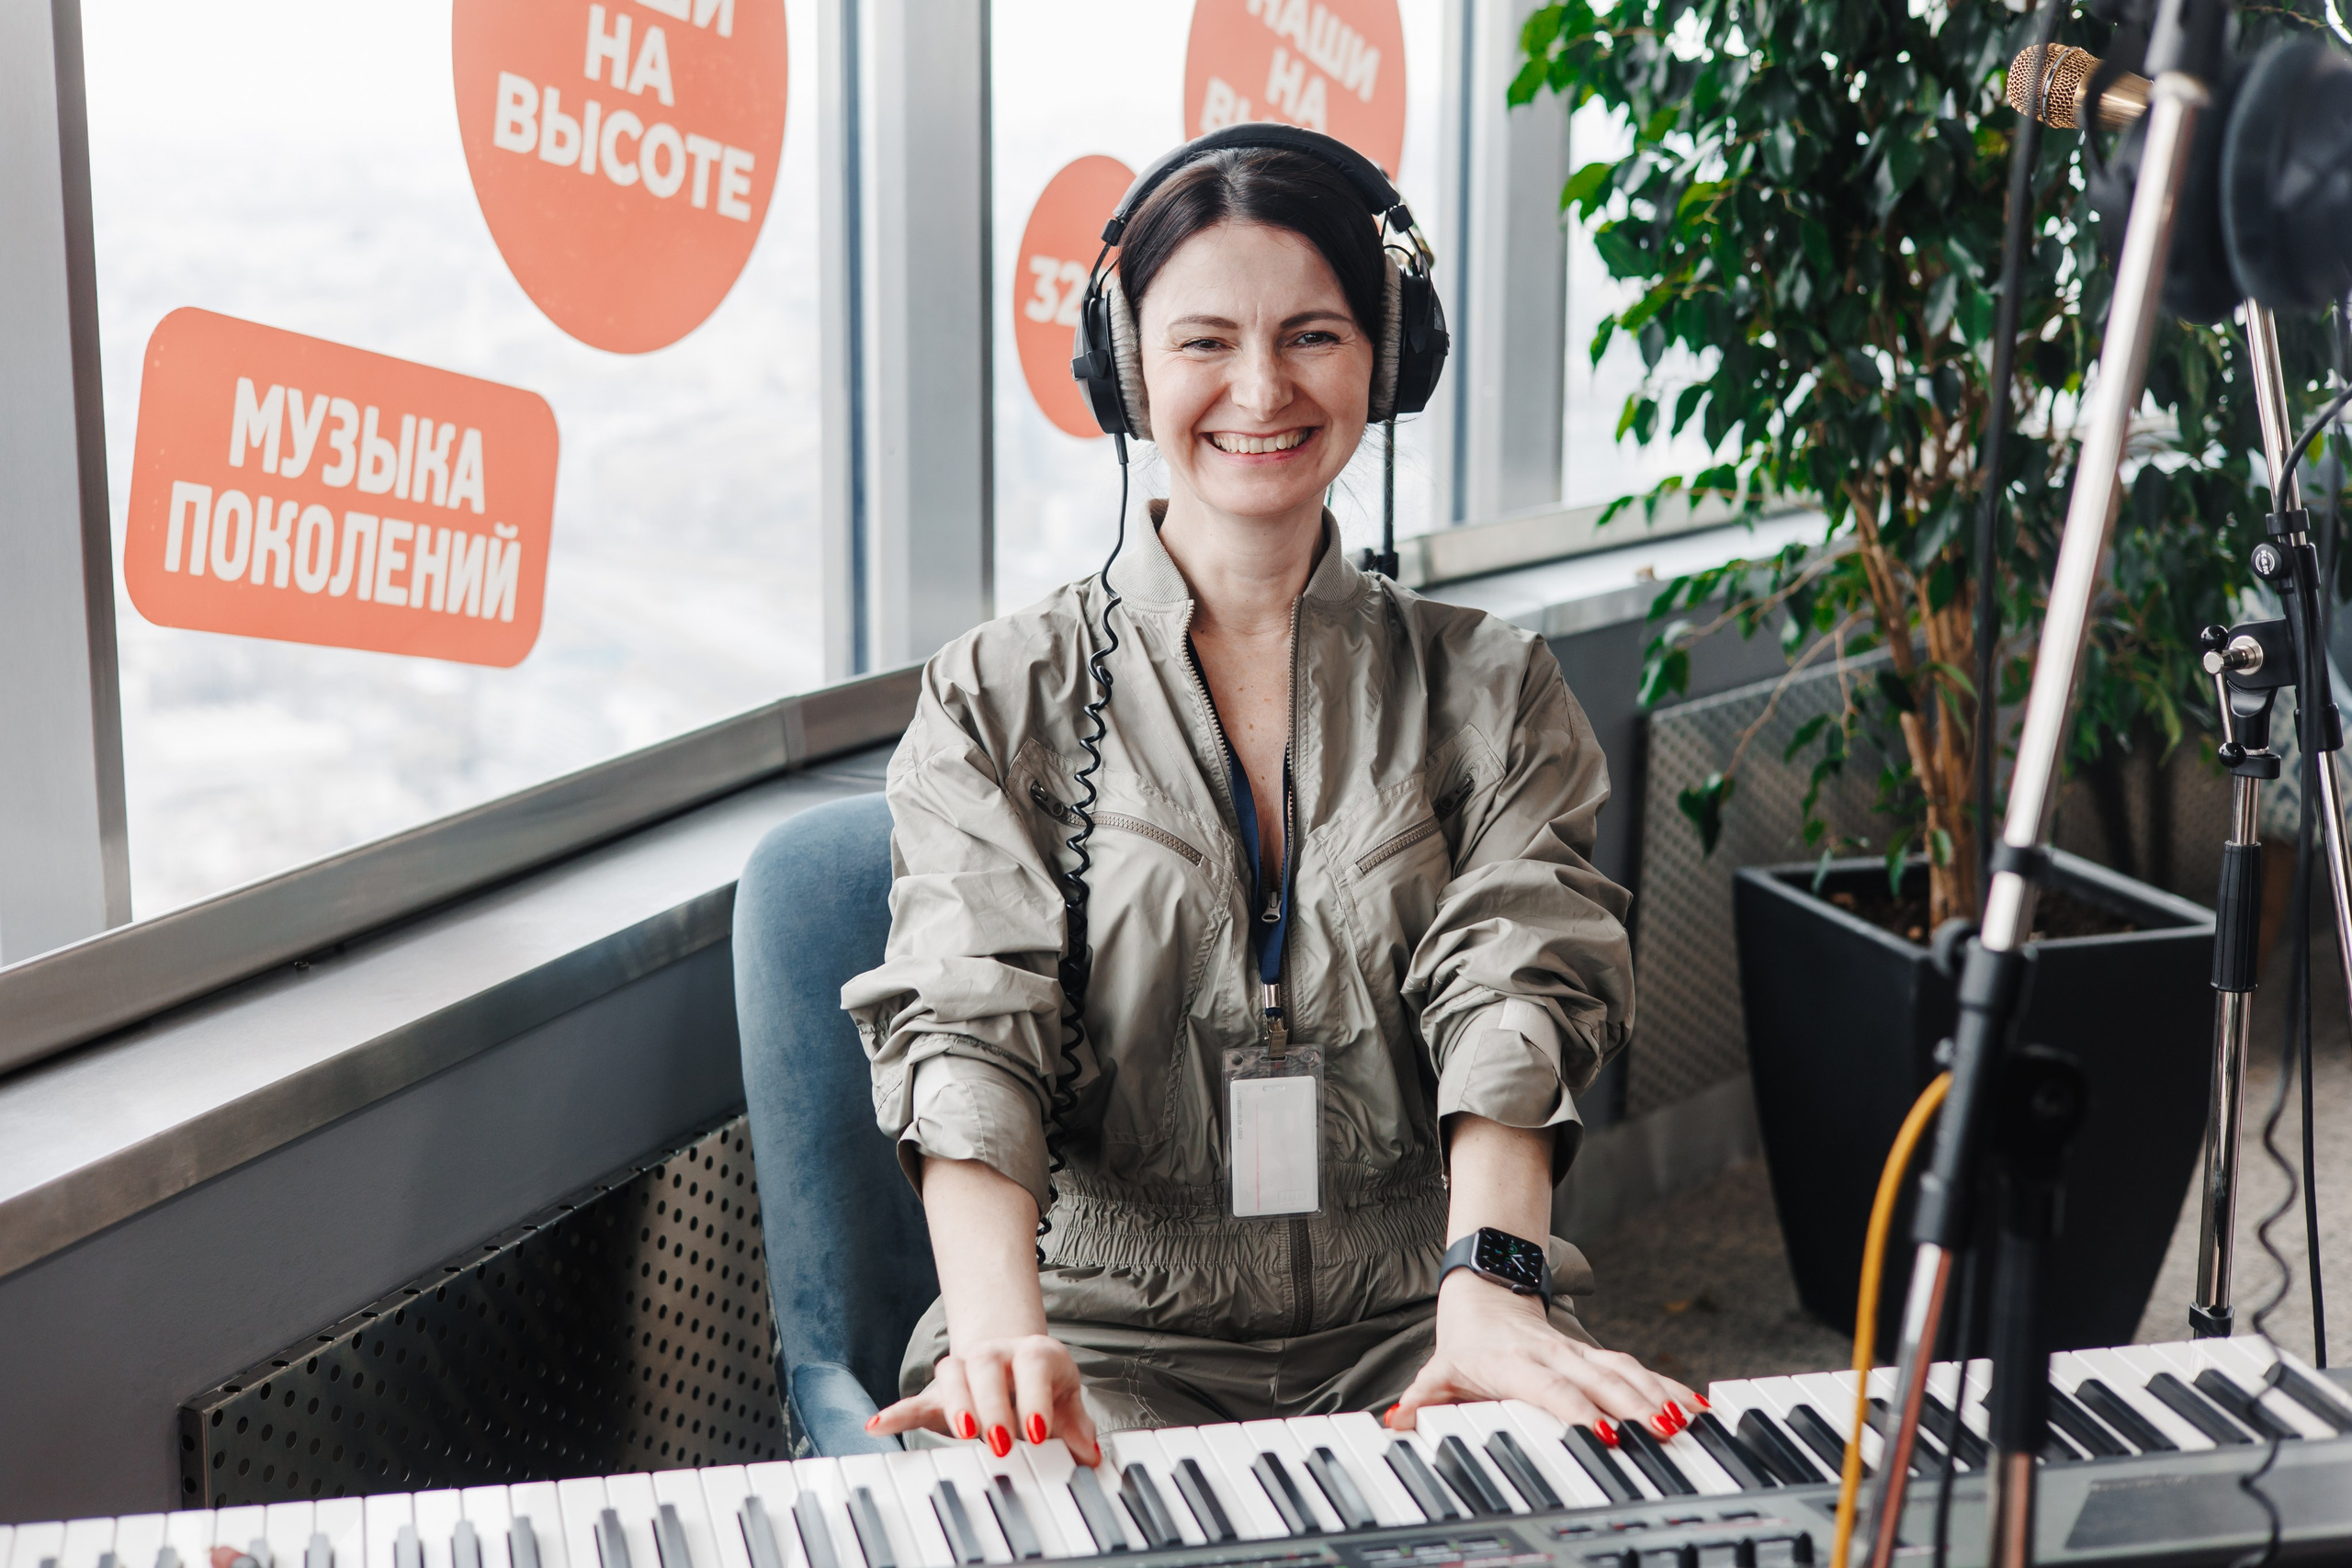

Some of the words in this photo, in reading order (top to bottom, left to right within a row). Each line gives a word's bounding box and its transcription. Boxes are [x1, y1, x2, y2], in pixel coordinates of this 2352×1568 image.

[583, 3, 675, 107] НА
[1265, 46, 1328, 134] НА
[493, 70, 755, 223] ВЫСОТЕ
[229, 377, 485, 514] МУЗЫКА
[164, 479, 522, 623] ПОКОЛЕНИЙ
[2260, 549, 2270, 575] K&M
